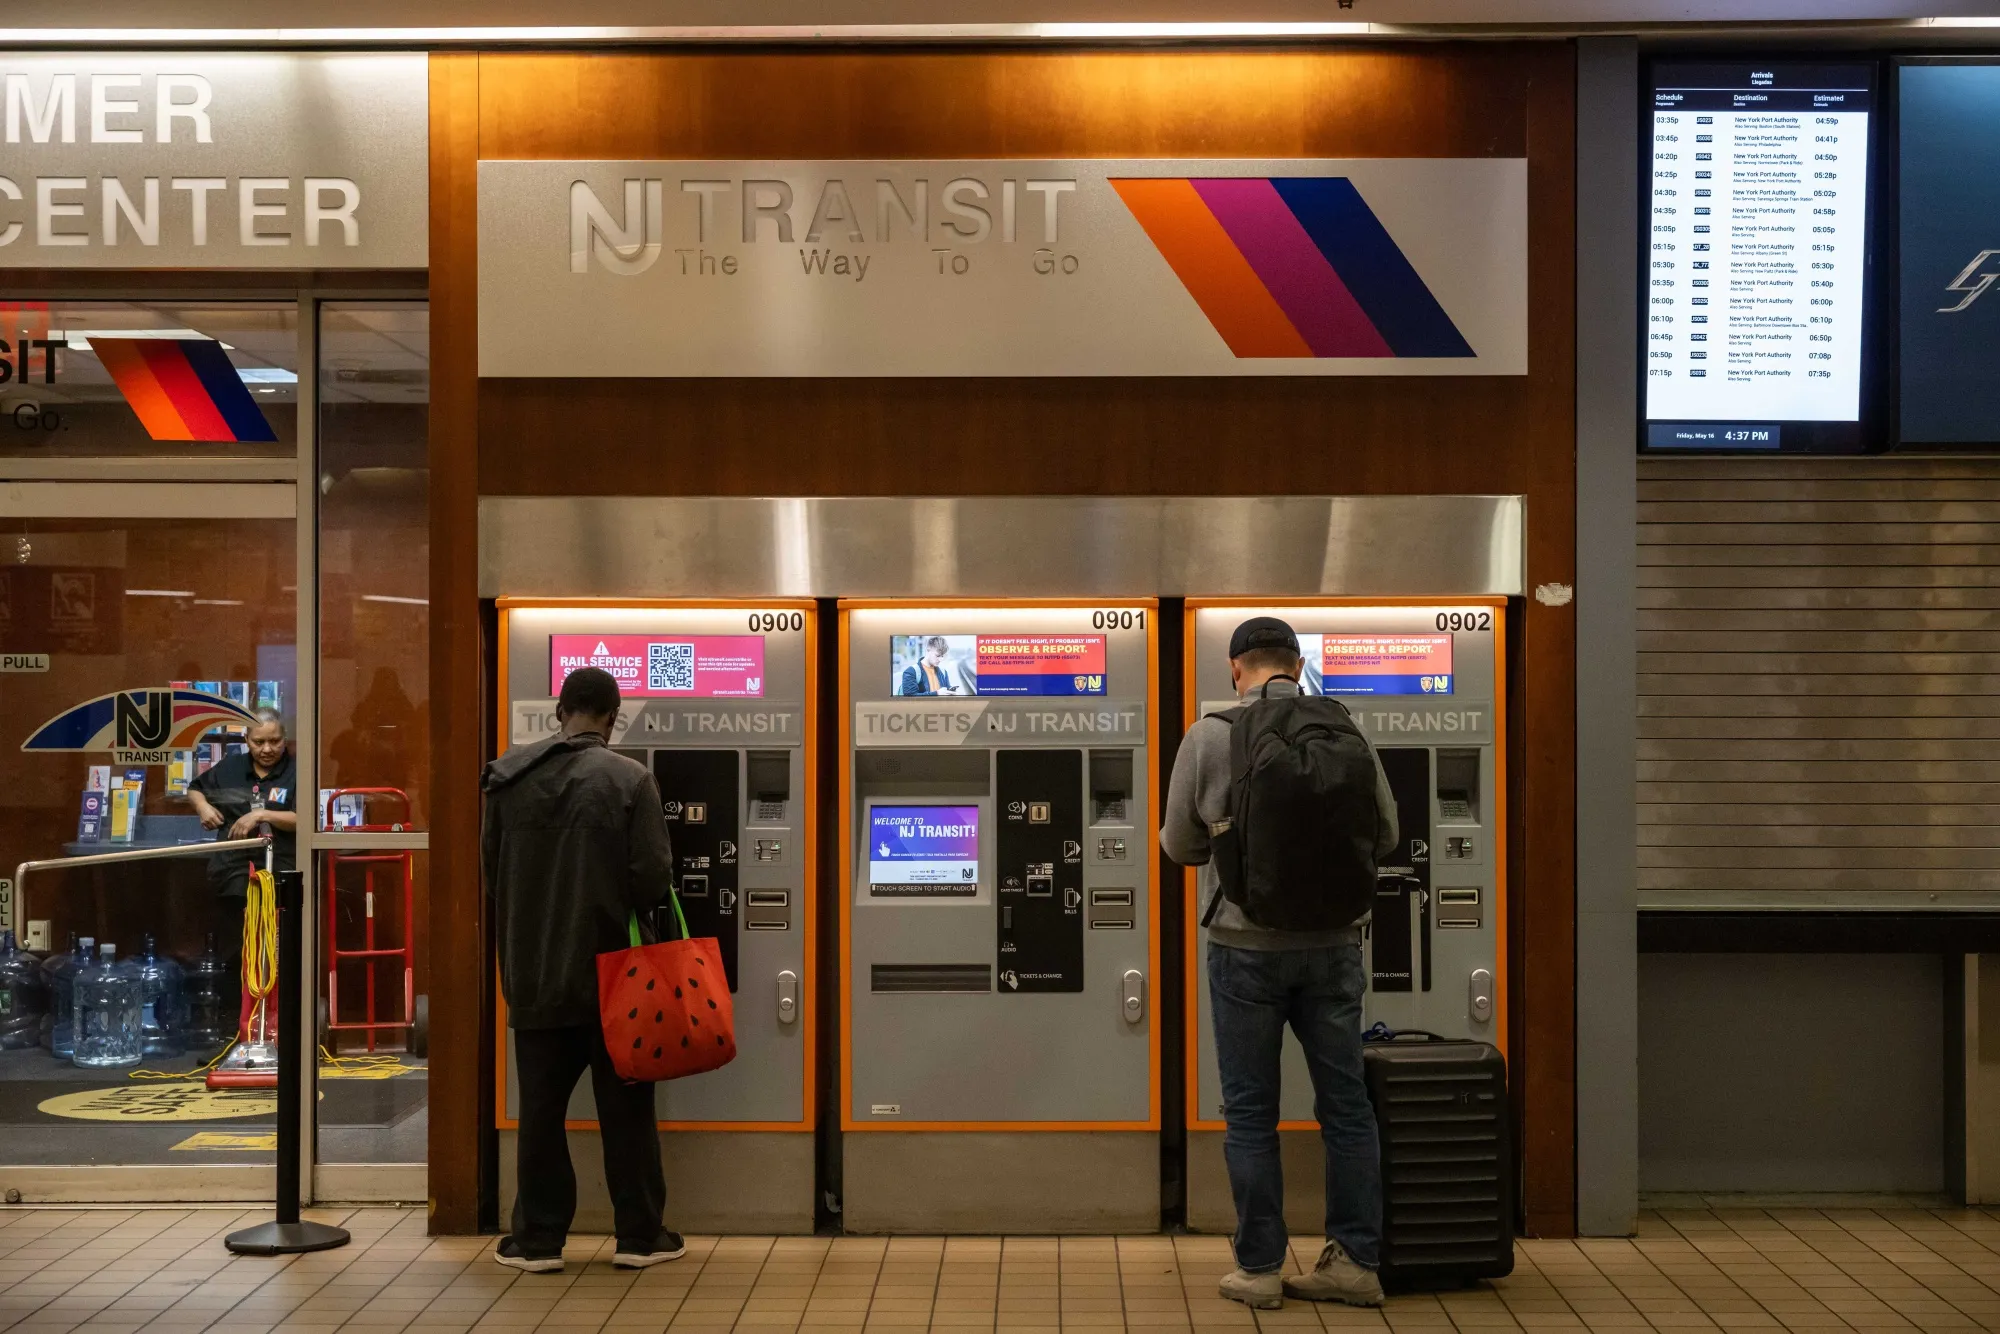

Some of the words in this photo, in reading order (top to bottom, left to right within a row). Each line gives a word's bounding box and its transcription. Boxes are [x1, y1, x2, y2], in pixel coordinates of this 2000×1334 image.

[5, 73, 214, 143] MER
[569, 178, 662, 276] NJ
[680, 177, 1078, 243] TRANSIT
[675, 248, 738, 275] The
[800, 248, 871, 282] Way
[932, 248, 969, 275] To
[1032, 248, 1079, 276] Go
[1695, 432, 1707, 440] May
[1725, 431, 1749, 440] 4:37
[1752, 431, 1769, 440] PM
[749, 612, 803, 632] 0900
[1092, 610, 1145, 630] 0901
[1436, 612, 1490, 631] 0902
[980, 645, 1030, 654] OBSERVE
[1325, 646, 1376, 654] OBSERVE
[1379, 645, 1386, 653] &
[1389, 645, 1433, 653] REPORT.
[3, 656, 44, 670] PULL
[560, 657, 588, 666] RAIL
[590, 657, 642, 666] SERVICE
[564, 667, 638, 678] SNDED
[746, 678, 760, 690] NJ
[1088, 676, 1101, 688] NJ
[1435, 676, 1448, 689] NJ
[116, 692, 172, 749] NJ
[522, 712, 628, 732] TICS
[644, 713, 674, 732] NJ
[683, 712, 792, 733] TRANSIT
[864, 713, 971, 733] TICKETS
[987, 712, 1017, 732] NJ
[1026, 712, 1135, 732] TRANSIT
[1372, 712, 1482, 732] TRANSIT
[117, 751, 171, 762] TRANSIT
[900, 826, 914, 837] NJ
[918, 826, 975, 837] TRANSIT!
[962, 868, 973, 878] NJ
